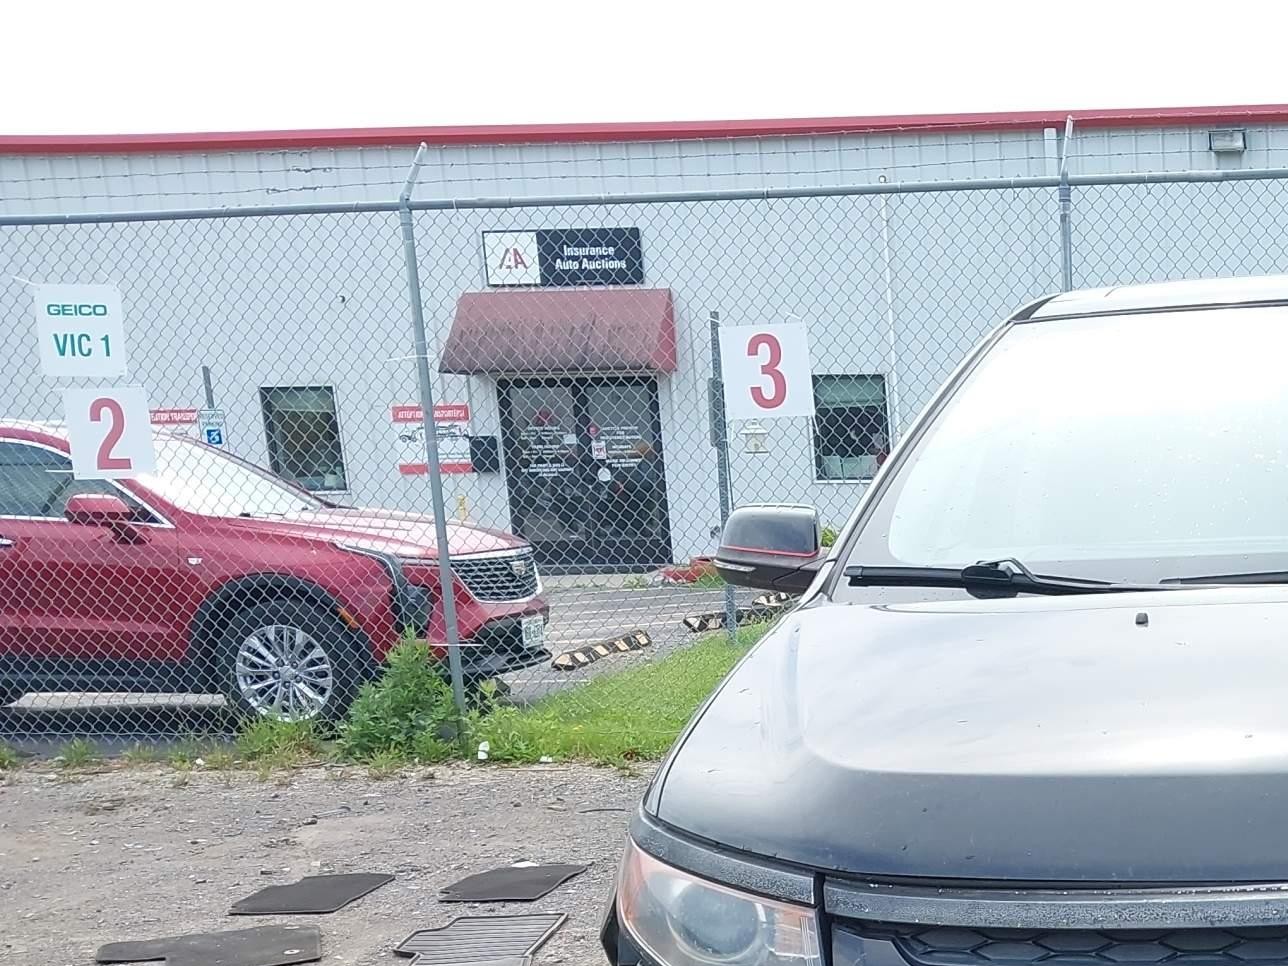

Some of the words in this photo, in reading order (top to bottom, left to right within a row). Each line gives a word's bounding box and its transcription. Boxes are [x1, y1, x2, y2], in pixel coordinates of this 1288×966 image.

[563, 244, 615, 256] Insurance
[555, 258, 580, 270] Auto
[581, 257, 627, 270] Auctions
[46, 303, 108, 316] GEICO
[53, 333, 92, 357] VIC
[100, 334, 110, 357] 1
[747, 333, 787, 409] 3
[89, 397, 132, 470] 2
